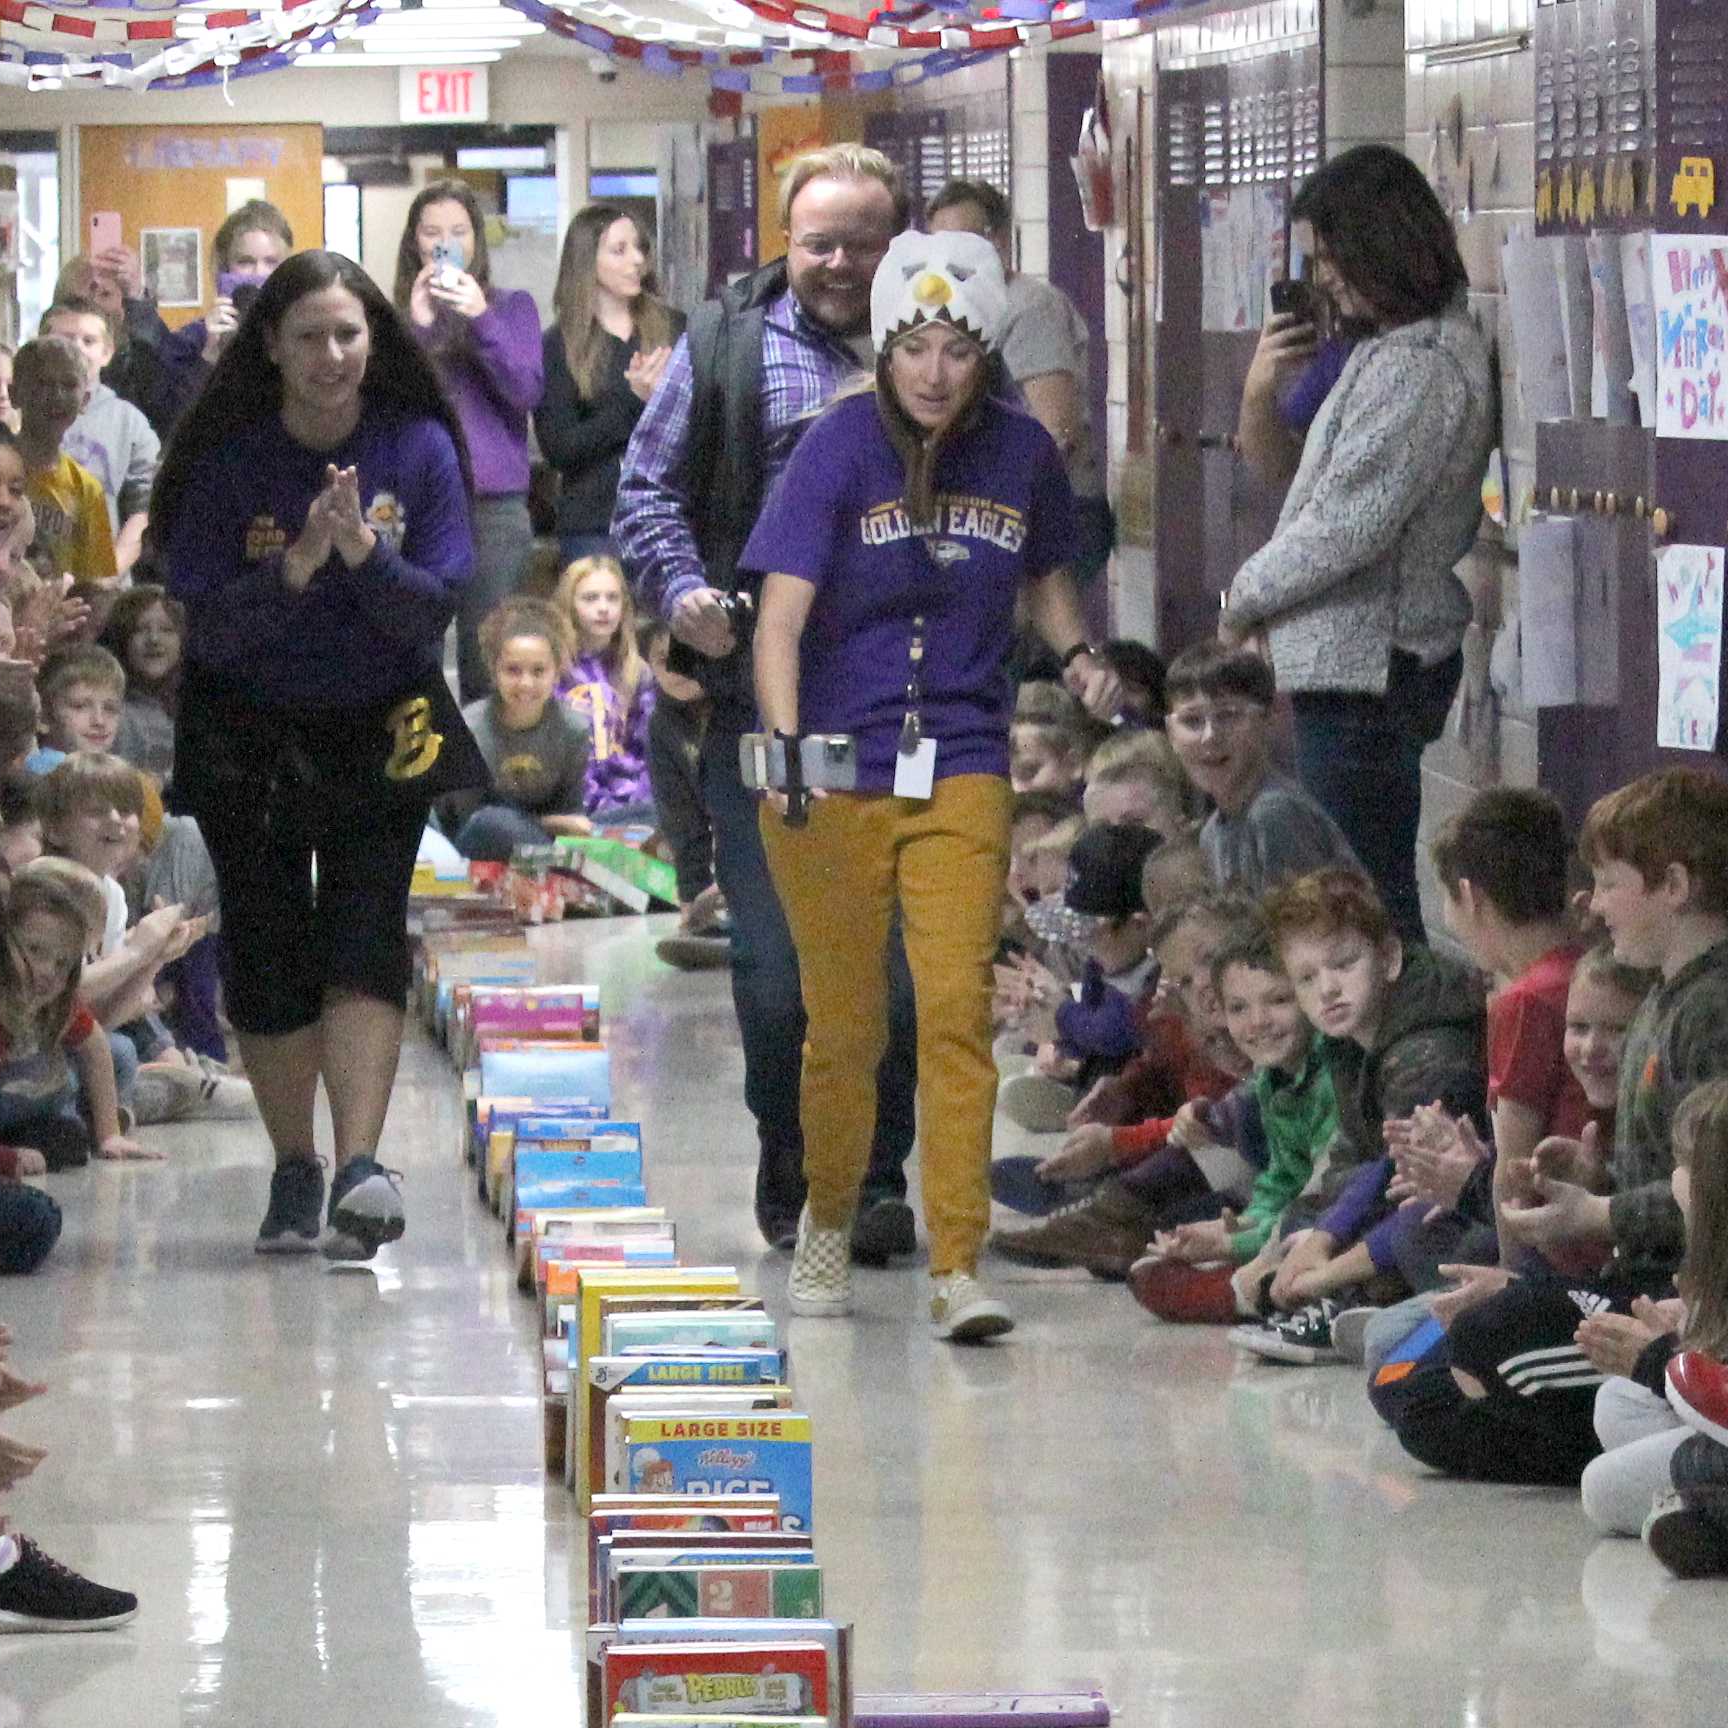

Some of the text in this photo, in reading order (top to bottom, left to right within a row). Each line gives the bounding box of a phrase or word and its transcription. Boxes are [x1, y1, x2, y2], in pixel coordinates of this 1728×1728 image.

[417, 69, 478, 113] EXIT
[948, 504, 1027, 553] EAGLES
[648, 1364, 746, 1381] LARGE SIZE
[660, 1421, 783, 1438] LARGE SIZE
